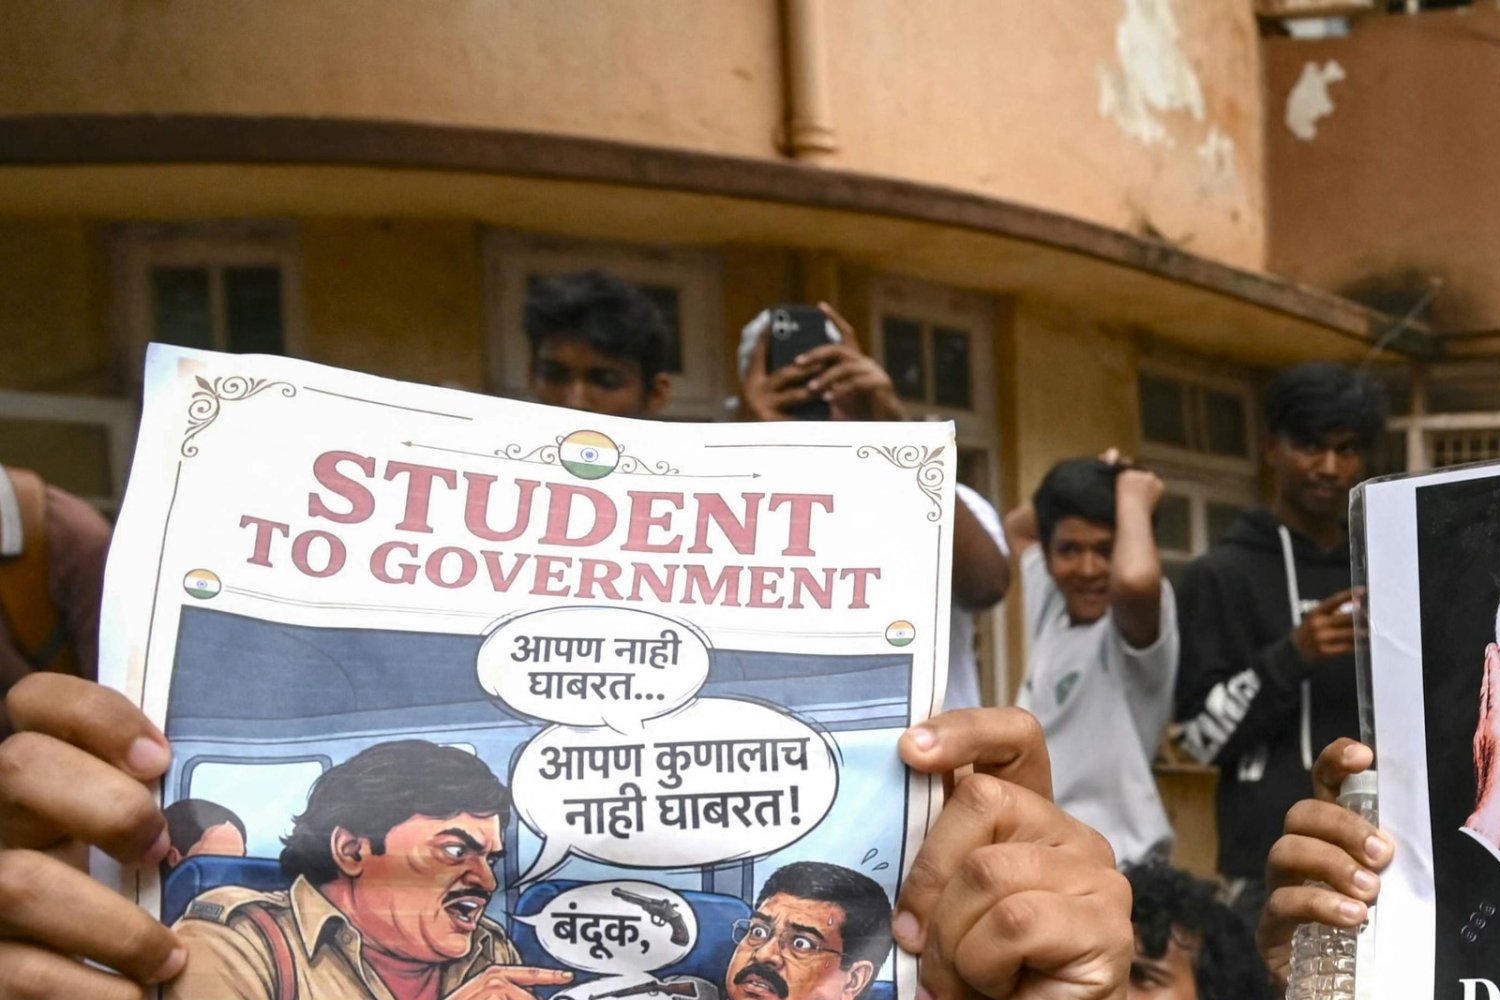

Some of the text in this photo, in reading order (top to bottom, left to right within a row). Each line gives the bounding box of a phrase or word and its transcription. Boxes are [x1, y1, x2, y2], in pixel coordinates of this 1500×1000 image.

[308, 450, 834, 557] STUDENT
[239, 515, 881, 609] TO GOVERNMENT
[510, 629, 682, 669] आपण नाही
[528, 672, 665, 701] घाबरत...
[538, 737, 810, 789] आपण कुणालाच
[563, 782, 801, 839] नाही घाबरत!
[551, 901, 651, 959] बंदूक,
